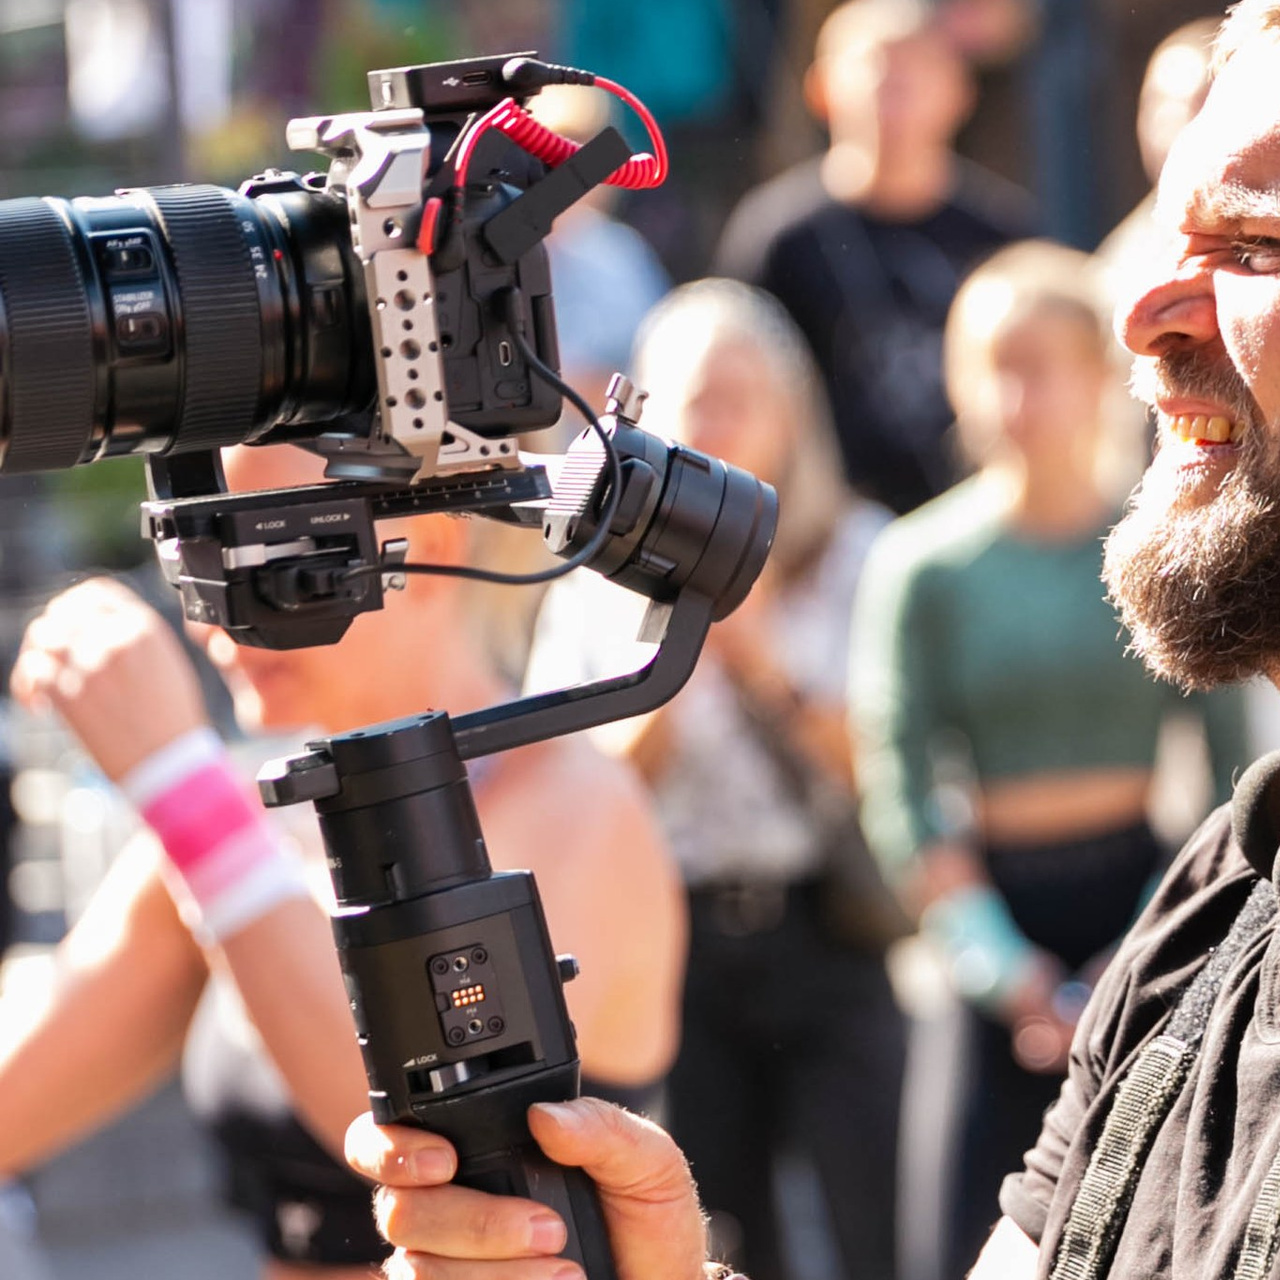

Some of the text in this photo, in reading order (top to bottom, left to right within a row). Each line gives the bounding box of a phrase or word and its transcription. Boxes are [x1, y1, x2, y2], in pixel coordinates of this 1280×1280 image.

[250, 246, 263, 259] 35
[254, 264, 267, 278] 24
[263, 520, 286, 530] LOCK
[310, 514, 342, 524] UNLOCK
[416, 1053, 438, 1065] LOCK
